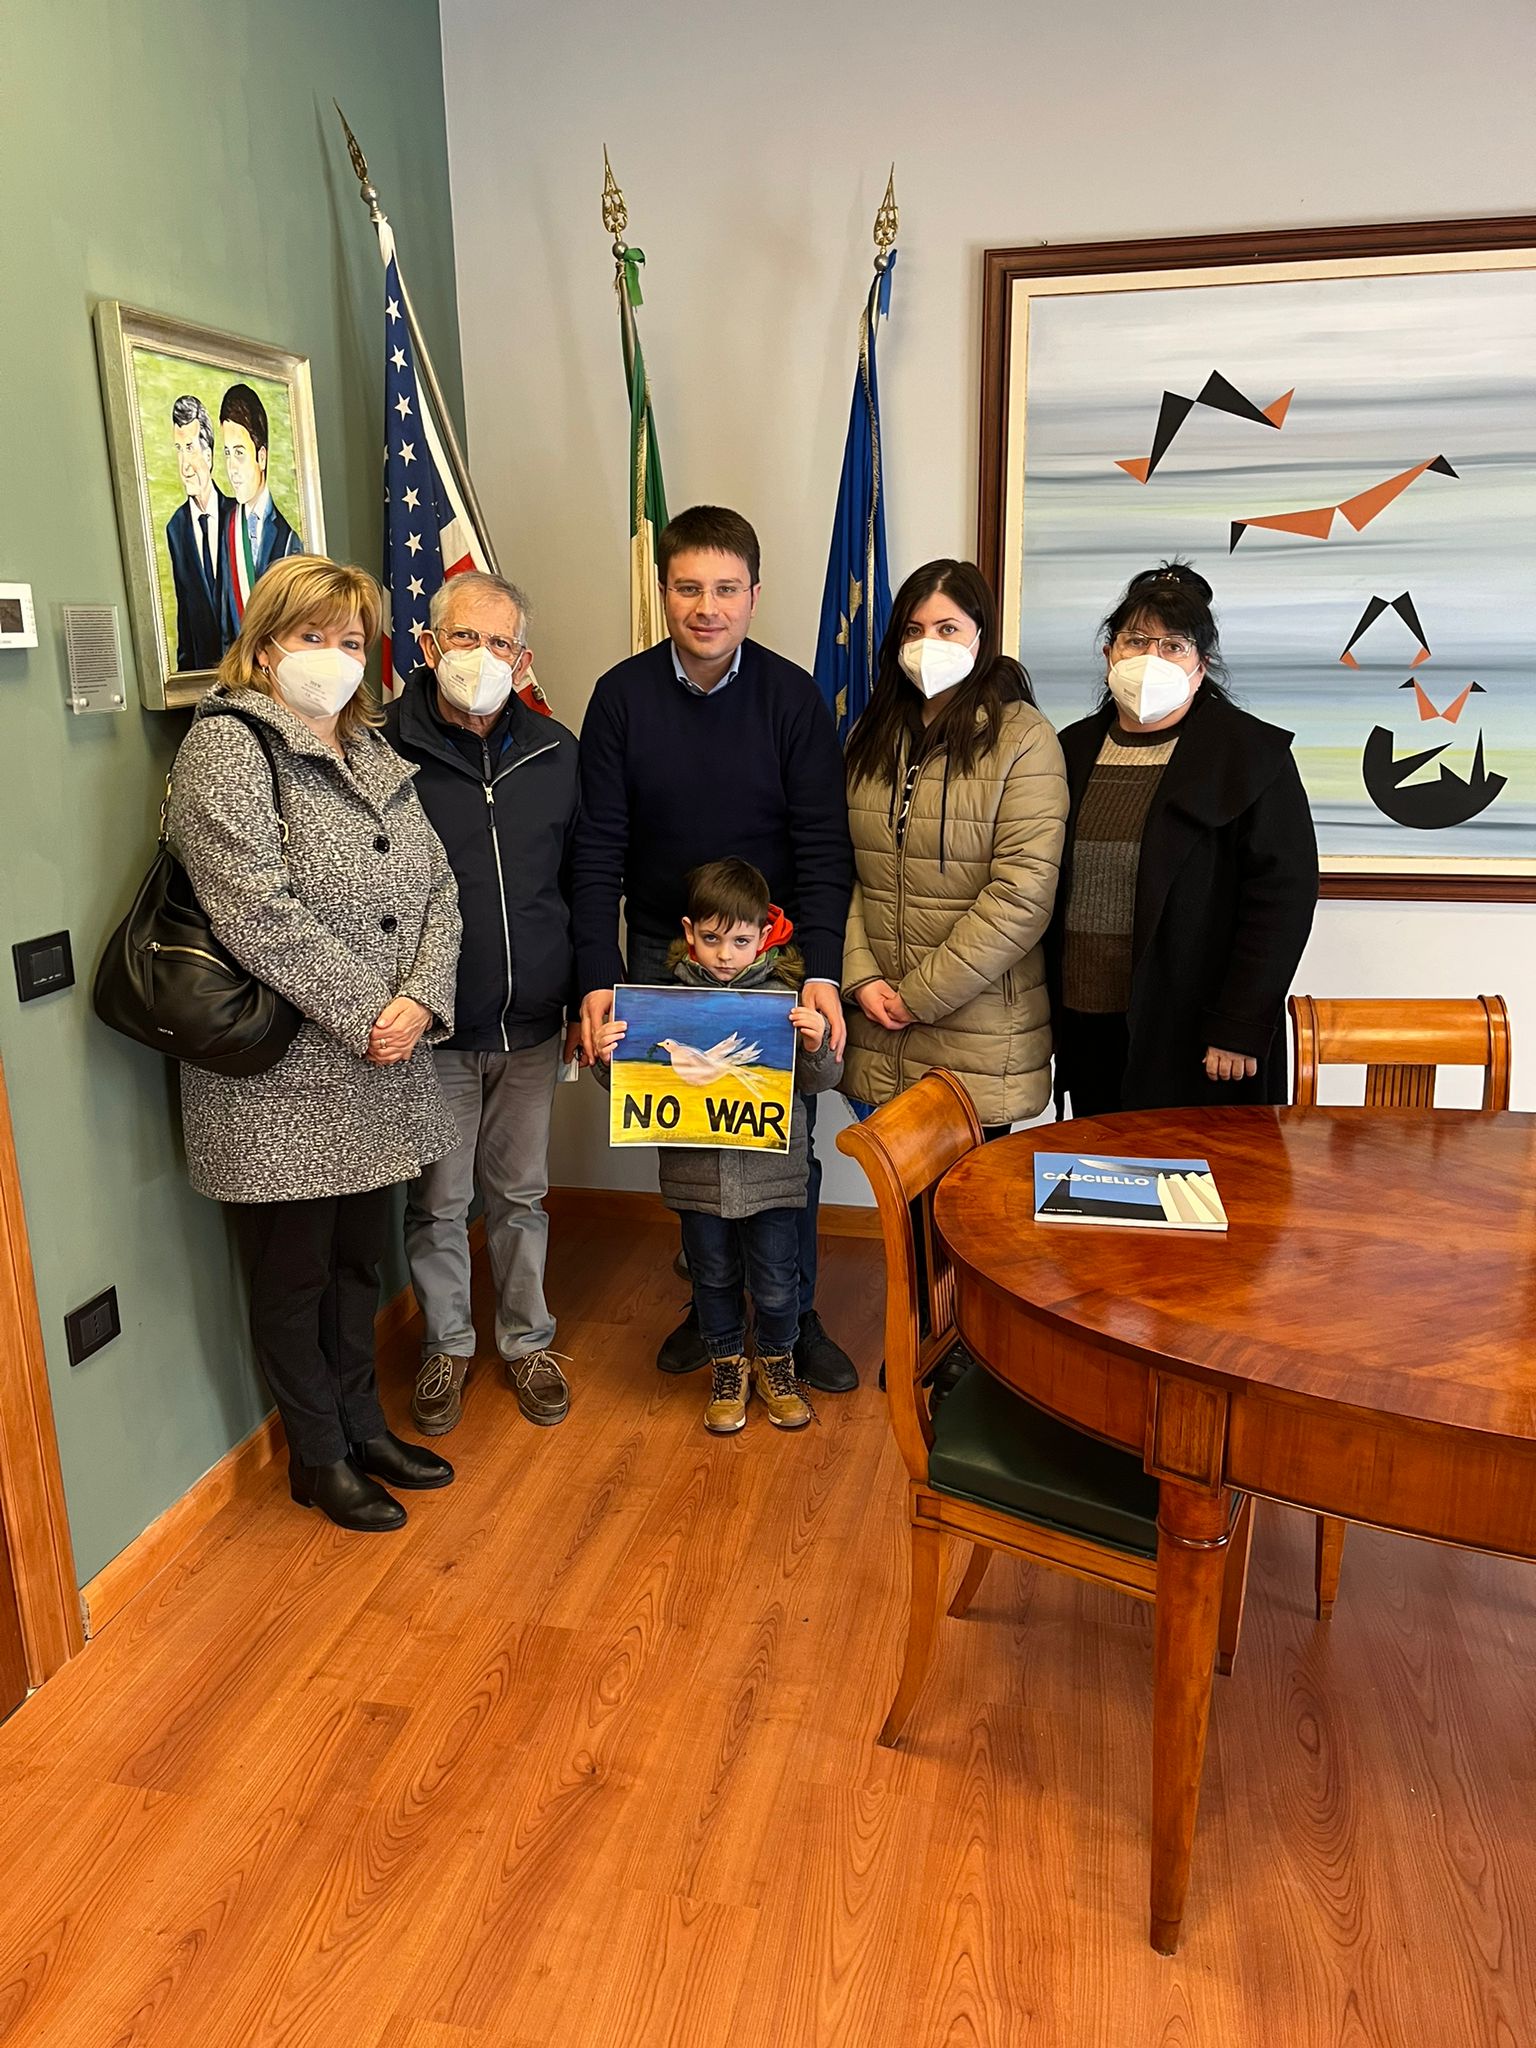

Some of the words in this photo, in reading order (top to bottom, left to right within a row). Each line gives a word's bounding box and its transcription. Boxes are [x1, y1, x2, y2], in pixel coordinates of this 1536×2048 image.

[623, 1094, 681, 1129] NO
[706, 1098, 787, 1140] WAR
[1042, 1172, 1150, 1185] CASCIELLO
